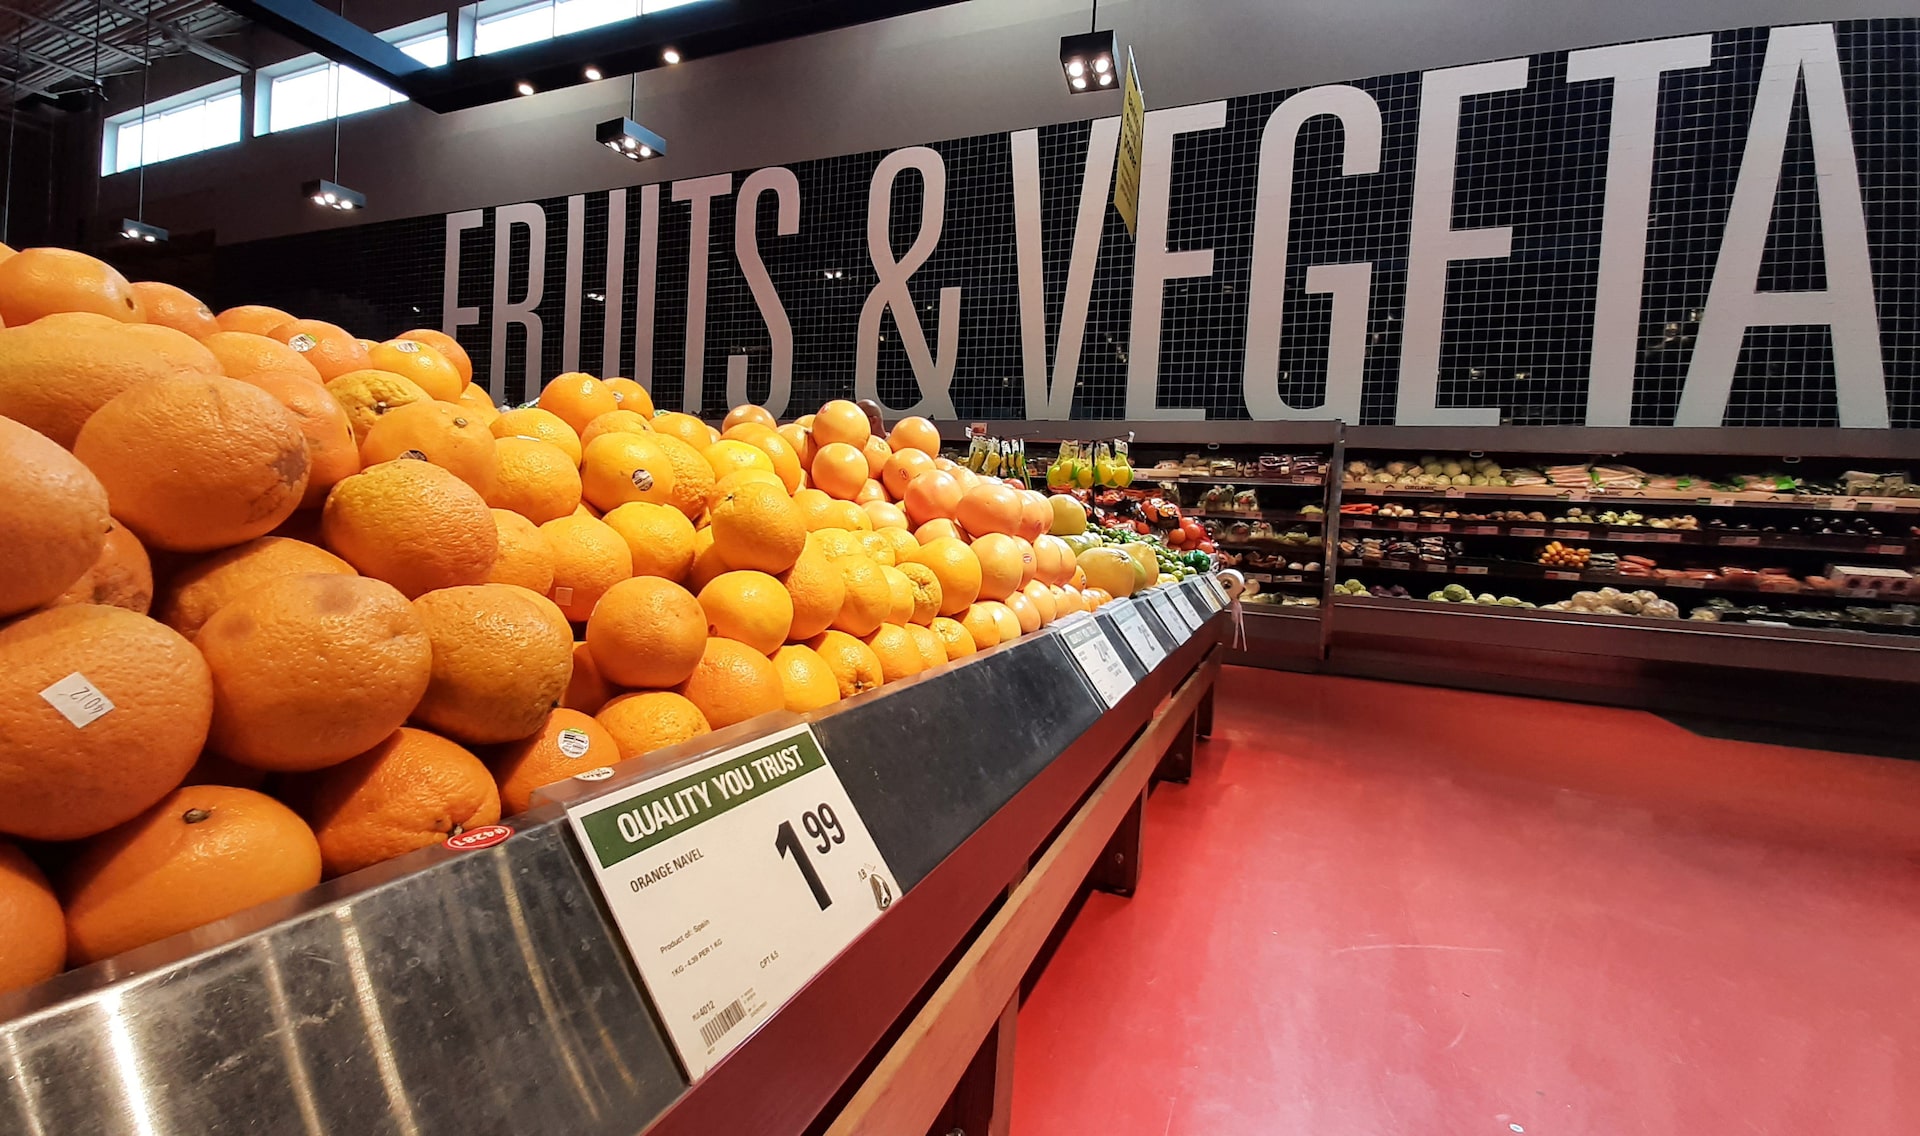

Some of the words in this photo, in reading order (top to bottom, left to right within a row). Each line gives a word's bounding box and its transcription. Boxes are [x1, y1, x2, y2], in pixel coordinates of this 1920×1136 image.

[442, 166, 800, 420] FRUITS
[854, 145, 962, 420] &
[1010, 24, 1890, 428] VEGETA
[70, 686, 105, 715] 4012
[616, 781, 713, 844] QUALITY
[711, 765, 755, 801] YOU
[751, 744, 805, 783] TRUST
[629, 862, 675, 893] ORANGE
[673, 847, 705, 872] NAVEL
[659, 935, 684, 954] Product
